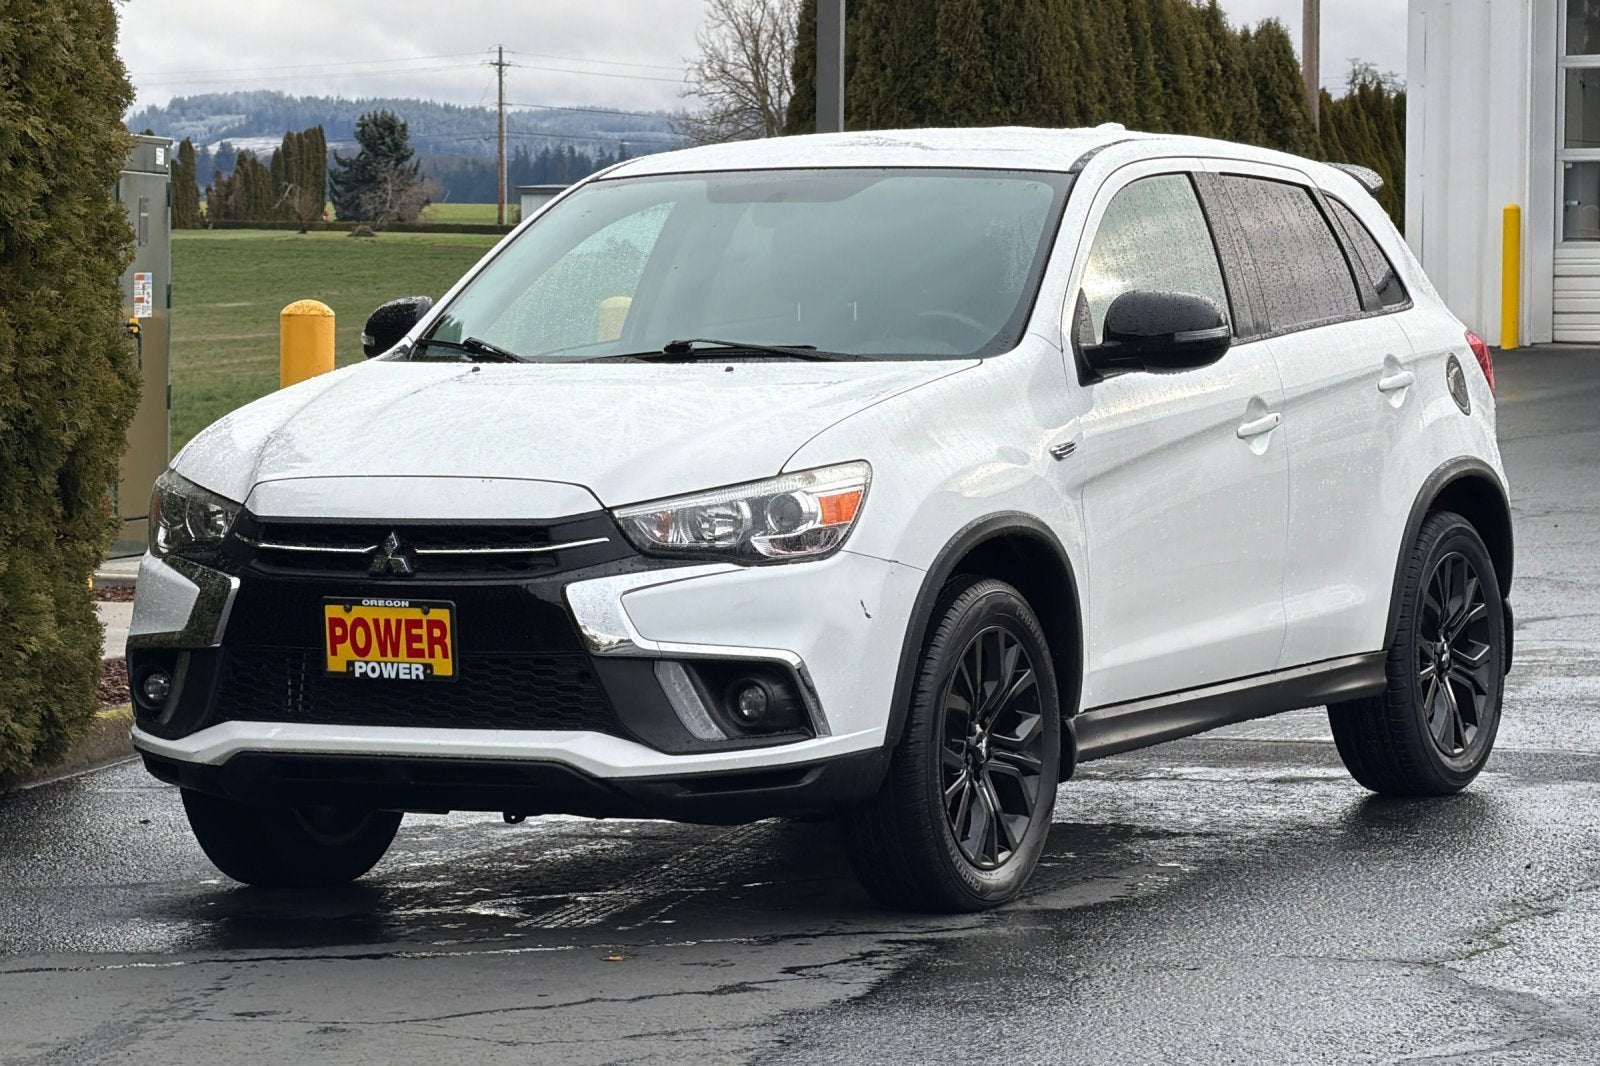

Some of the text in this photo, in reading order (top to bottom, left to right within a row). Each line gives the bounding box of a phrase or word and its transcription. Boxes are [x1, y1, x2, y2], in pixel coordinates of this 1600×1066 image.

[361, 599, 410, 607] OREGON
[328, 617, 449, 659] POWER
[354, 661, 425, 680] POWER
